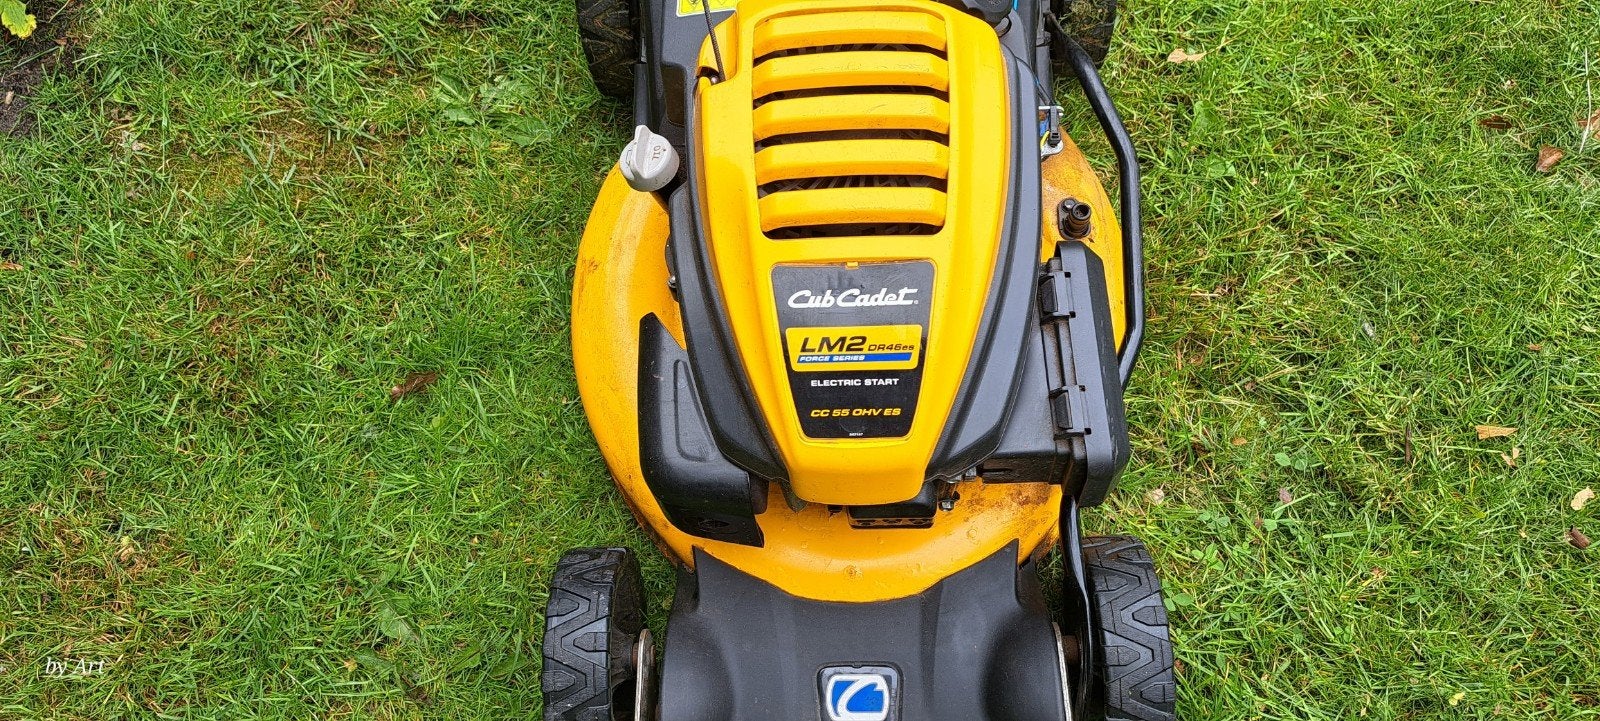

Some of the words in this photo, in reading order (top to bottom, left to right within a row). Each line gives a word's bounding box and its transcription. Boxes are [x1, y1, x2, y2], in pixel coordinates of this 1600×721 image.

[787, 289, 836, 309] Cub
[799, 335, 868, 353] LM2
[832, 354, 866, 362] SERIES
[810, 378, 862, 387] ELECTRIC
[864, 377, 900, 386] START
[810, 409, 831, 417] CC
[831, 408, 851, 417] 55
[852, 408, 883, 417] OHV
[883, 408, 902, 416] ES
